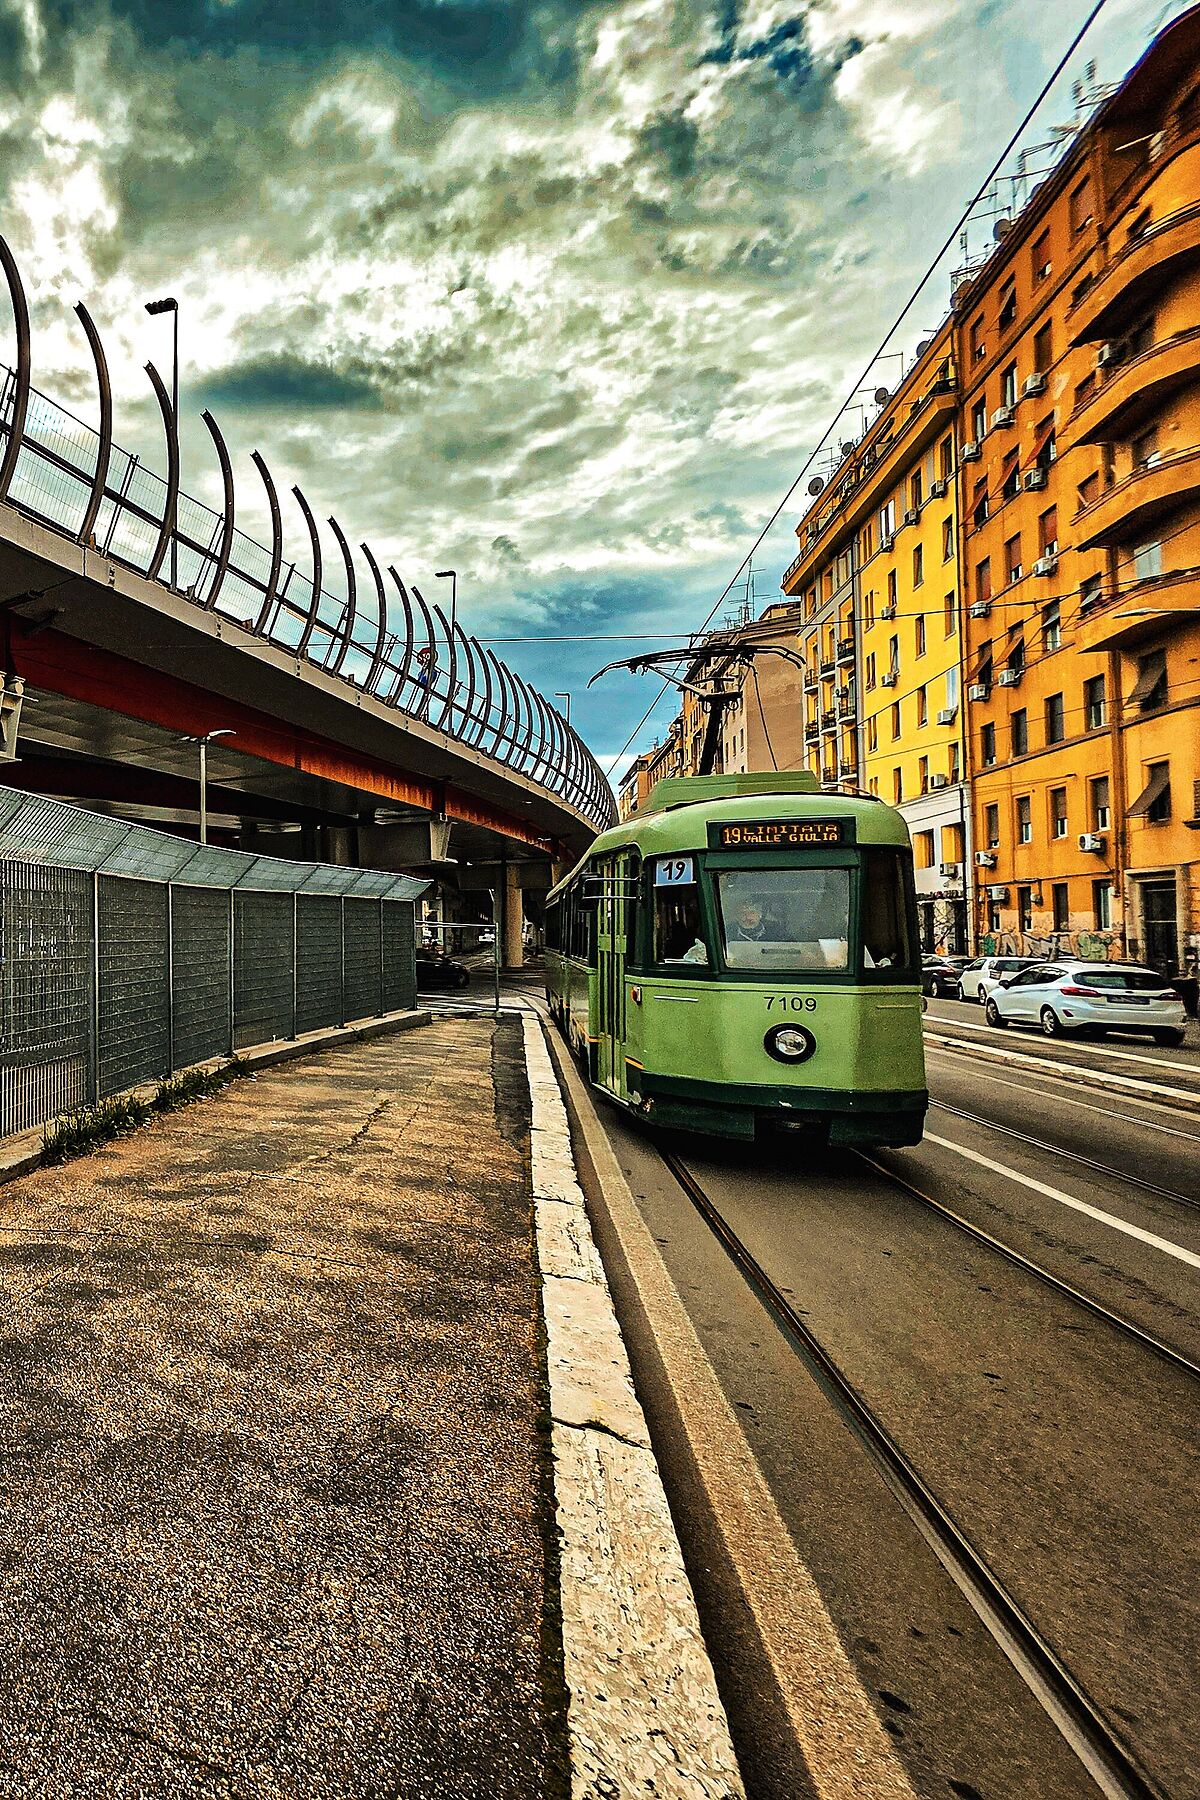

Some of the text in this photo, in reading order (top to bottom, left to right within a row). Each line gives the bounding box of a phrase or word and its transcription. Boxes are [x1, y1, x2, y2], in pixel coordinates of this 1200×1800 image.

[723, 827, 741, 844] 19
[743, 824, 838, 835] LIMITATA
[743, 833, 839, 843] VALLE GIULIA
[662, 860, 686, 881] 19
[763, 996, 817, 1012] 7109
